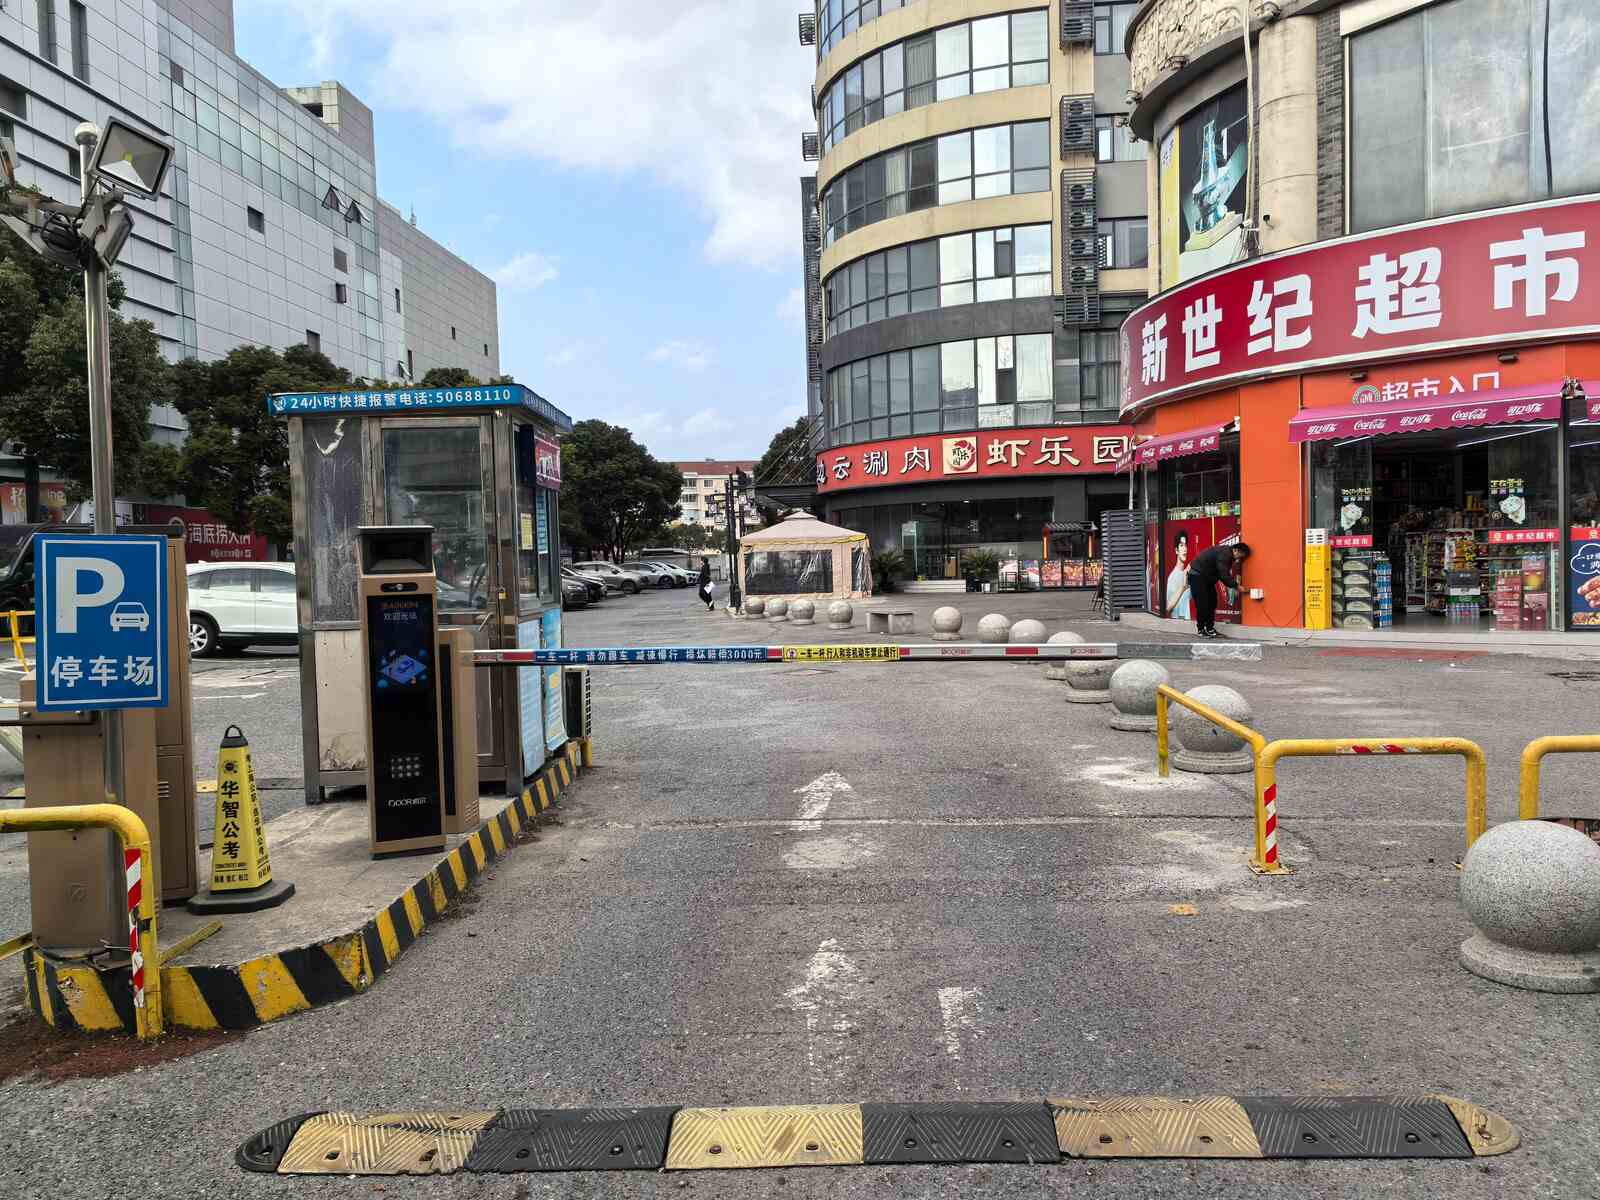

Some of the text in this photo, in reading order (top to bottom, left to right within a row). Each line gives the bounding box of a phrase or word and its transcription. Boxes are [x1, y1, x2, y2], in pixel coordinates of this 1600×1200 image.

[1141, 227, 1586, 386] 新世纪超市
[1381, 371, 1500, 401] 超市入口
[986, 435, 1128, 467] 虾乐园
[56, 557, 125, 633] P
[51, 655, 154, 688] 停车场
[221, 780, 241, 860] 华智公考
